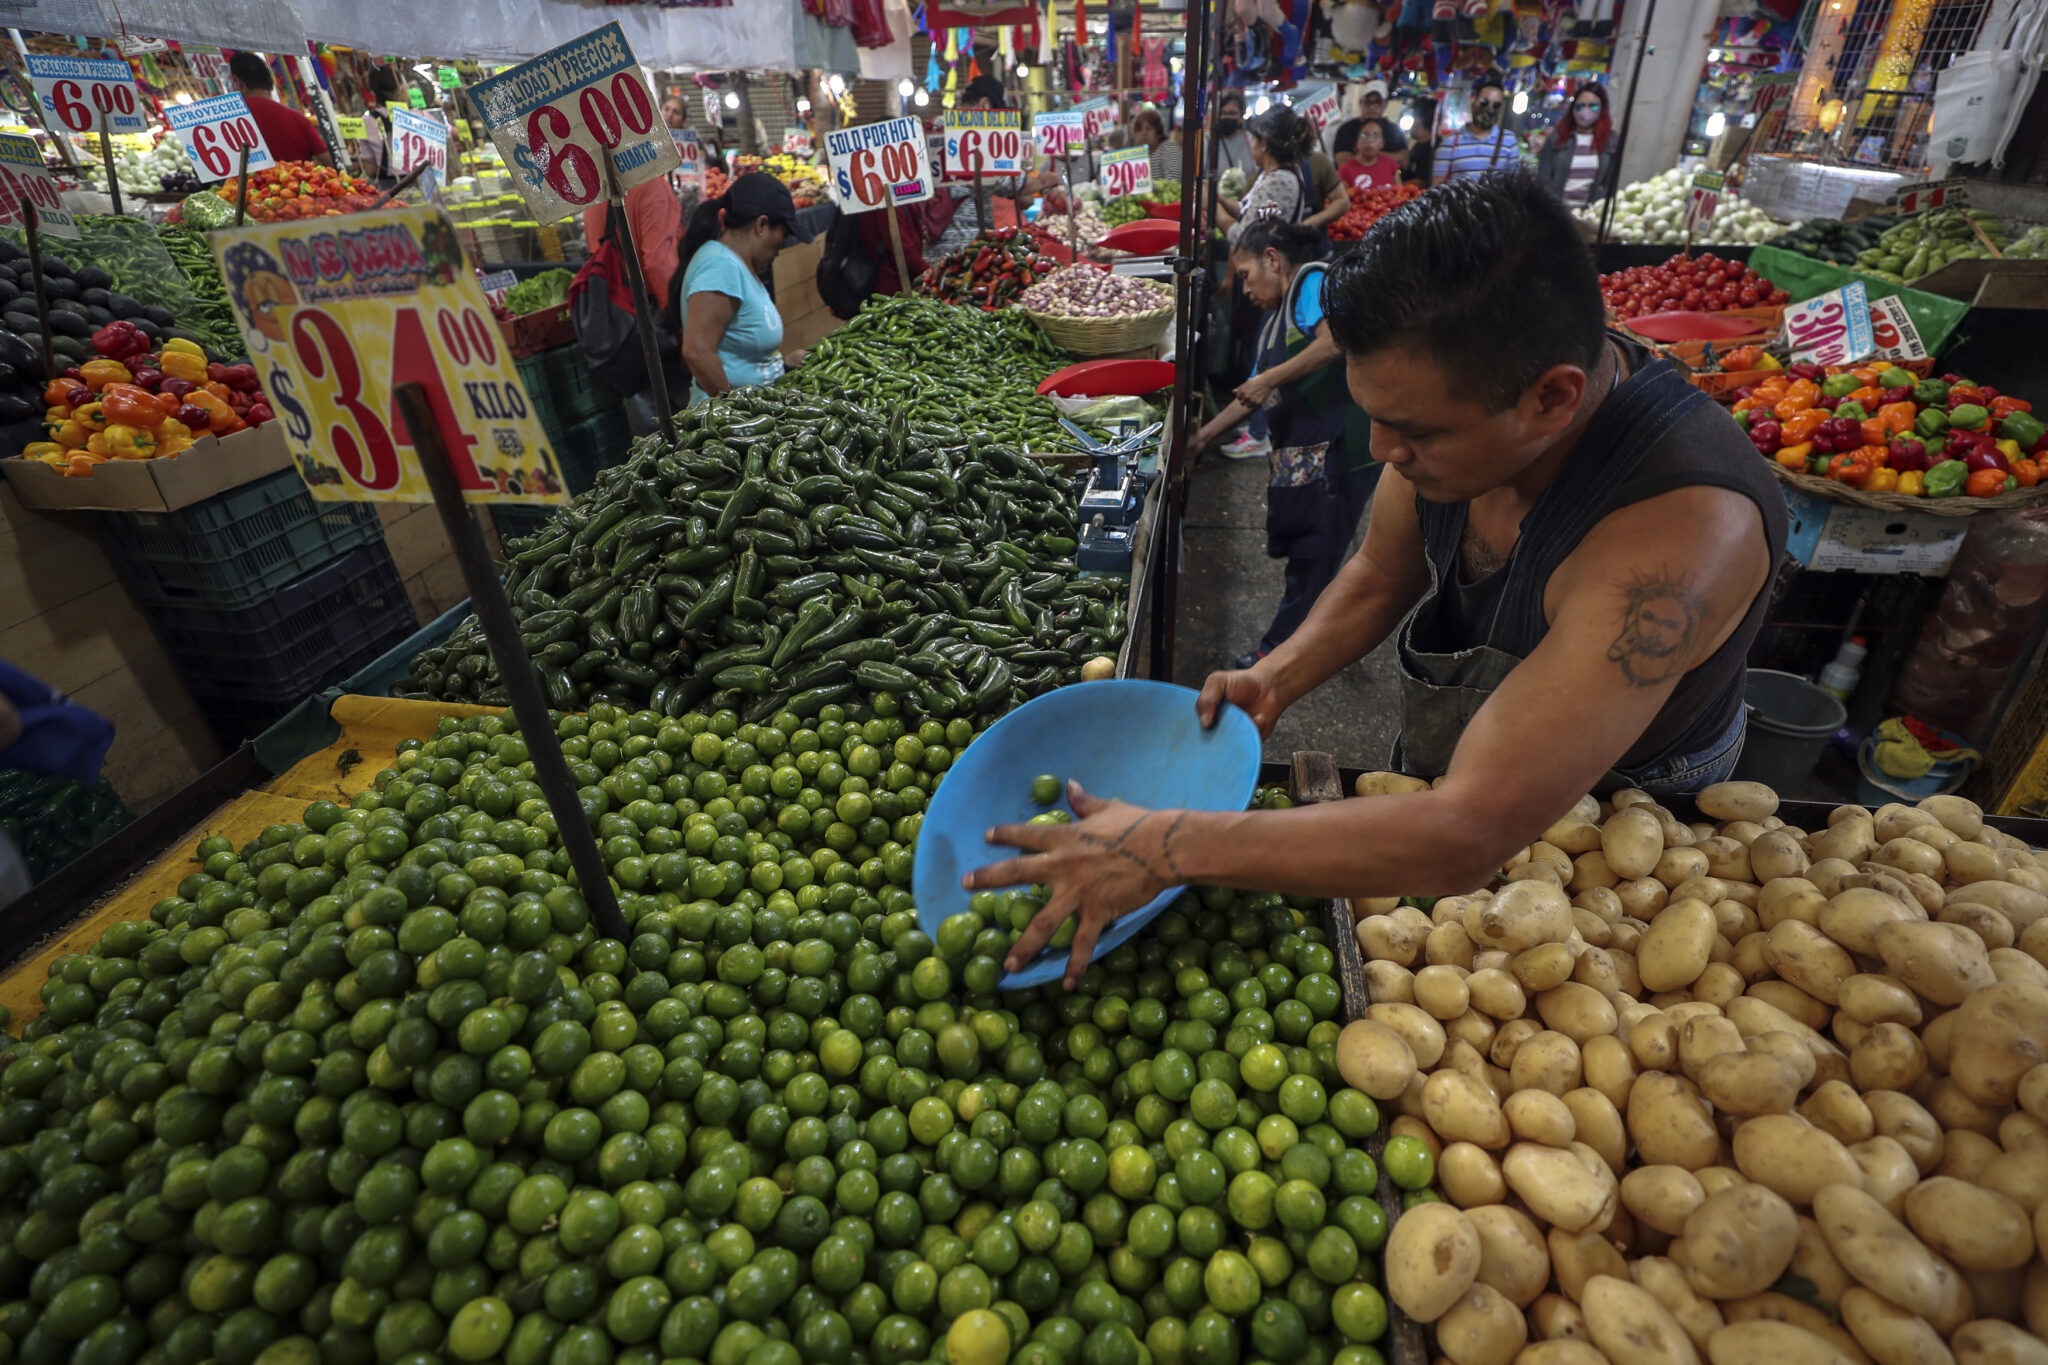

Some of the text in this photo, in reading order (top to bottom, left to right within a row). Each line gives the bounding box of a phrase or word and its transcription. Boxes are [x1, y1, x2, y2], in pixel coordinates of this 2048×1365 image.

[40, 61, 121, 77] CALIDAD Y PRECIO
[549, 66, 562, 86] Y
[561, 40, 614, 81] PRECIO
[172, 99, 244, 125] APROVECHE
[828, 116, 917, 156] SOLO POR HOY
[613, 140, 658, 175] CUARTO
[39, 209, 71, 226] KILO
[309, 231, 346, 282] SE
[463, 381, 528, 421] KILO
